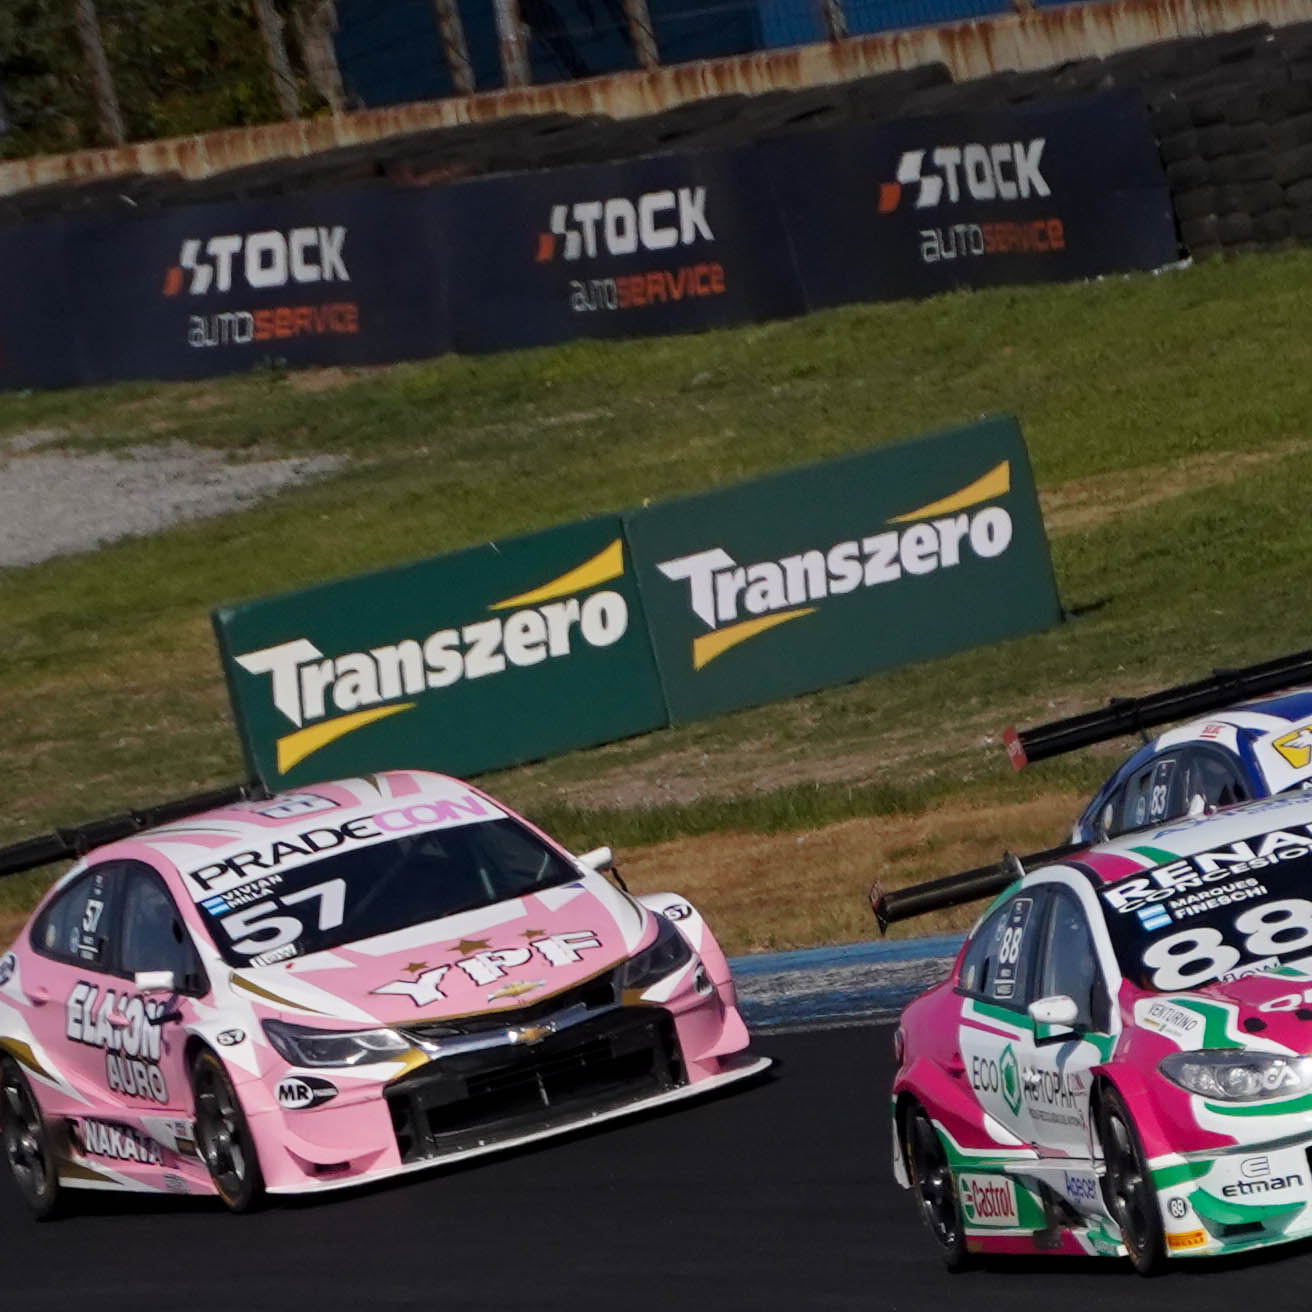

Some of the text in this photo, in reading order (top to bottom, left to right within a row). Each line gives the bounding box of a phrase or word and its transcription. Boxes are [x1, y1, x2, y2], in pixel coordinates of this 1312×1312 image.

[894, 137, 1051, 209] STOCK
[548, 187, 716, 260] STOCK
[178, 226, 350, 295] STOCK
[655, 505, 1014, 631] Transzero
[234, 589, 629, 730] Transzero
[188, 795, 488, 891] PRADECON
[220, 878, 346, 956] 57
[1168, 877, 1259, 909] MARQUES
[1174, 885, 1268, 920] FINESCHI
[369, 929, 603, 1007] YPF
[999, 926, 1023, 964] 88
[105, 1048, 168, 1105] AURO
[278, 1082, 310, 1102] MR
[972, 1055, 999, 1093] ECO
[971, 1179, 1017, 1219] Castrol
